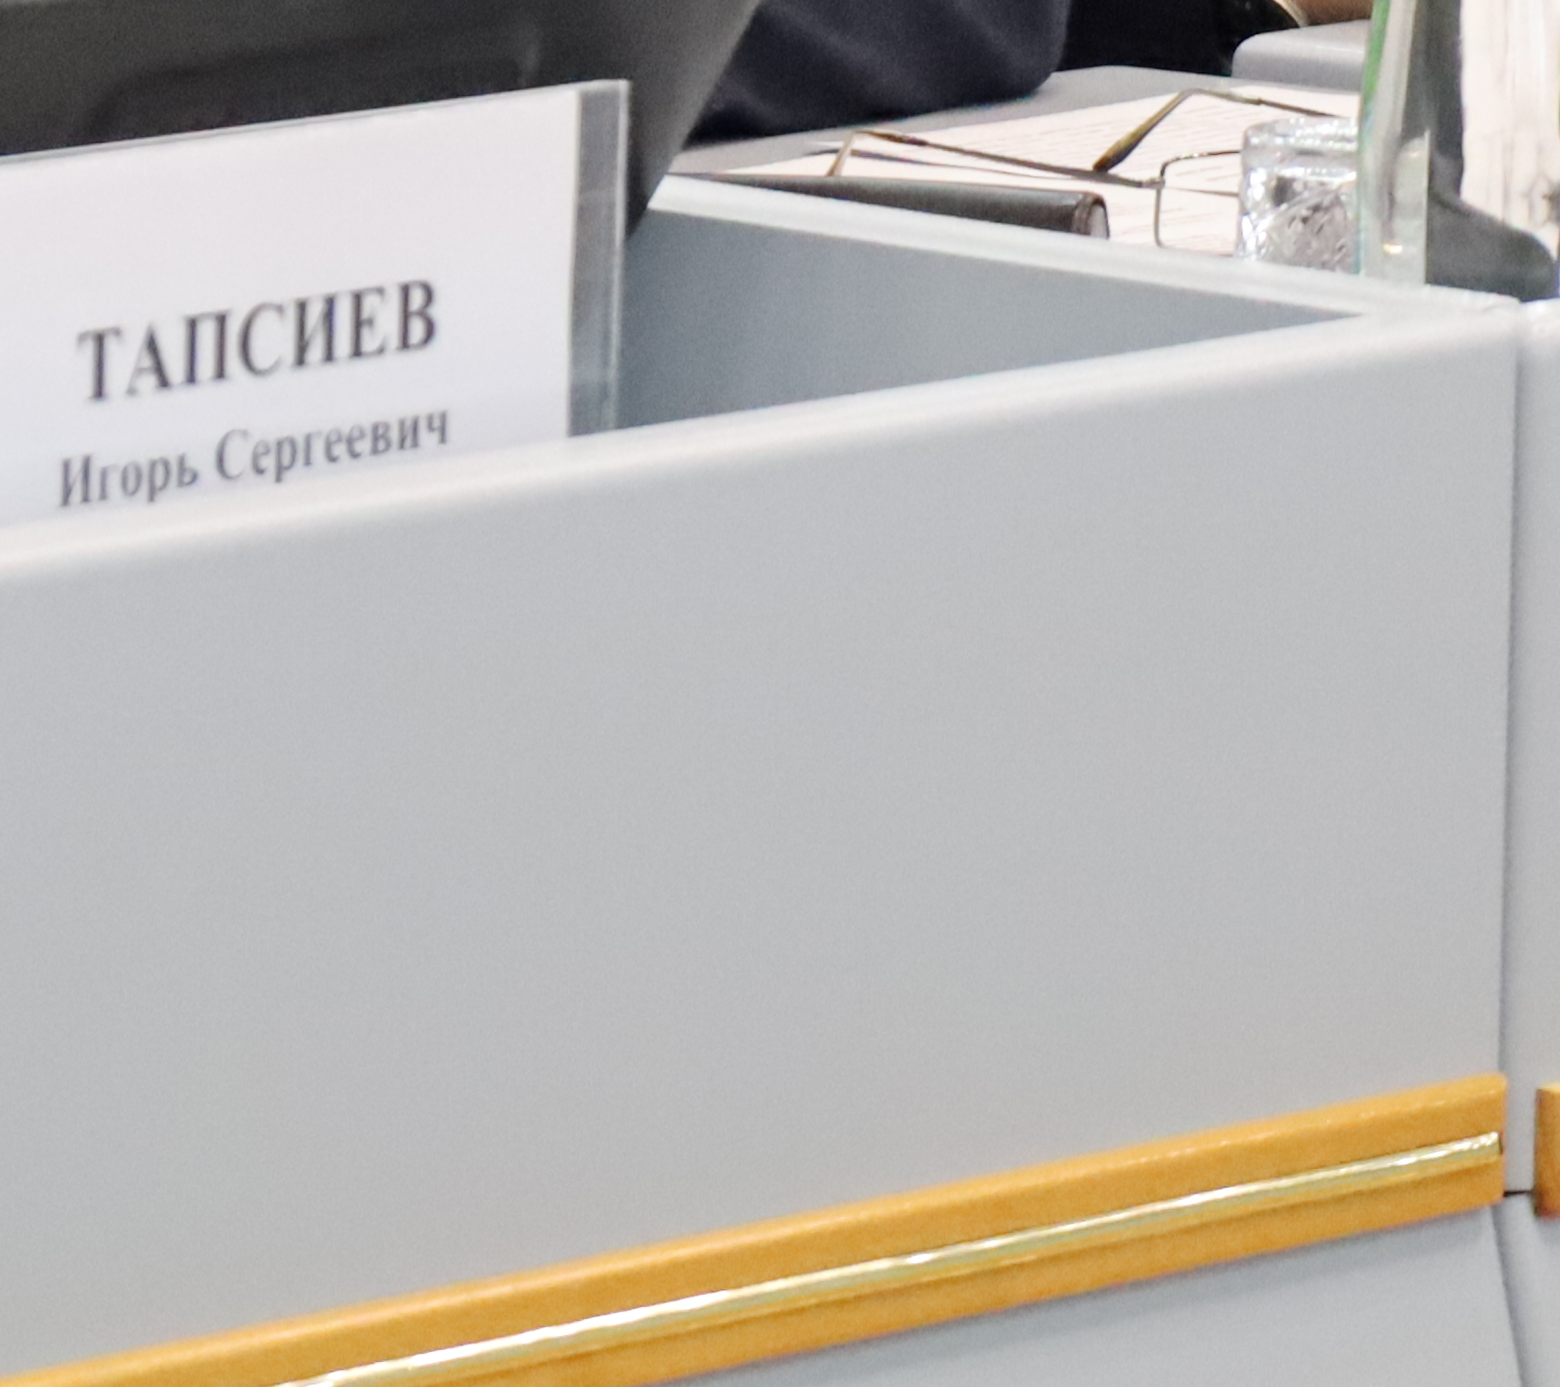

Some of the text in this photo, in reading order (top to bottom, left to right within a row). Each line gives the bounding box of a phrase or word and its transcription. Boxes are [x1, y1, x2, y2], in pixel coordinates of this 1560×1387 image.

[78, 279, 437, 403] ТАПСИЕВ
[59, 409, 450, 508] Игорь Сергеевич
